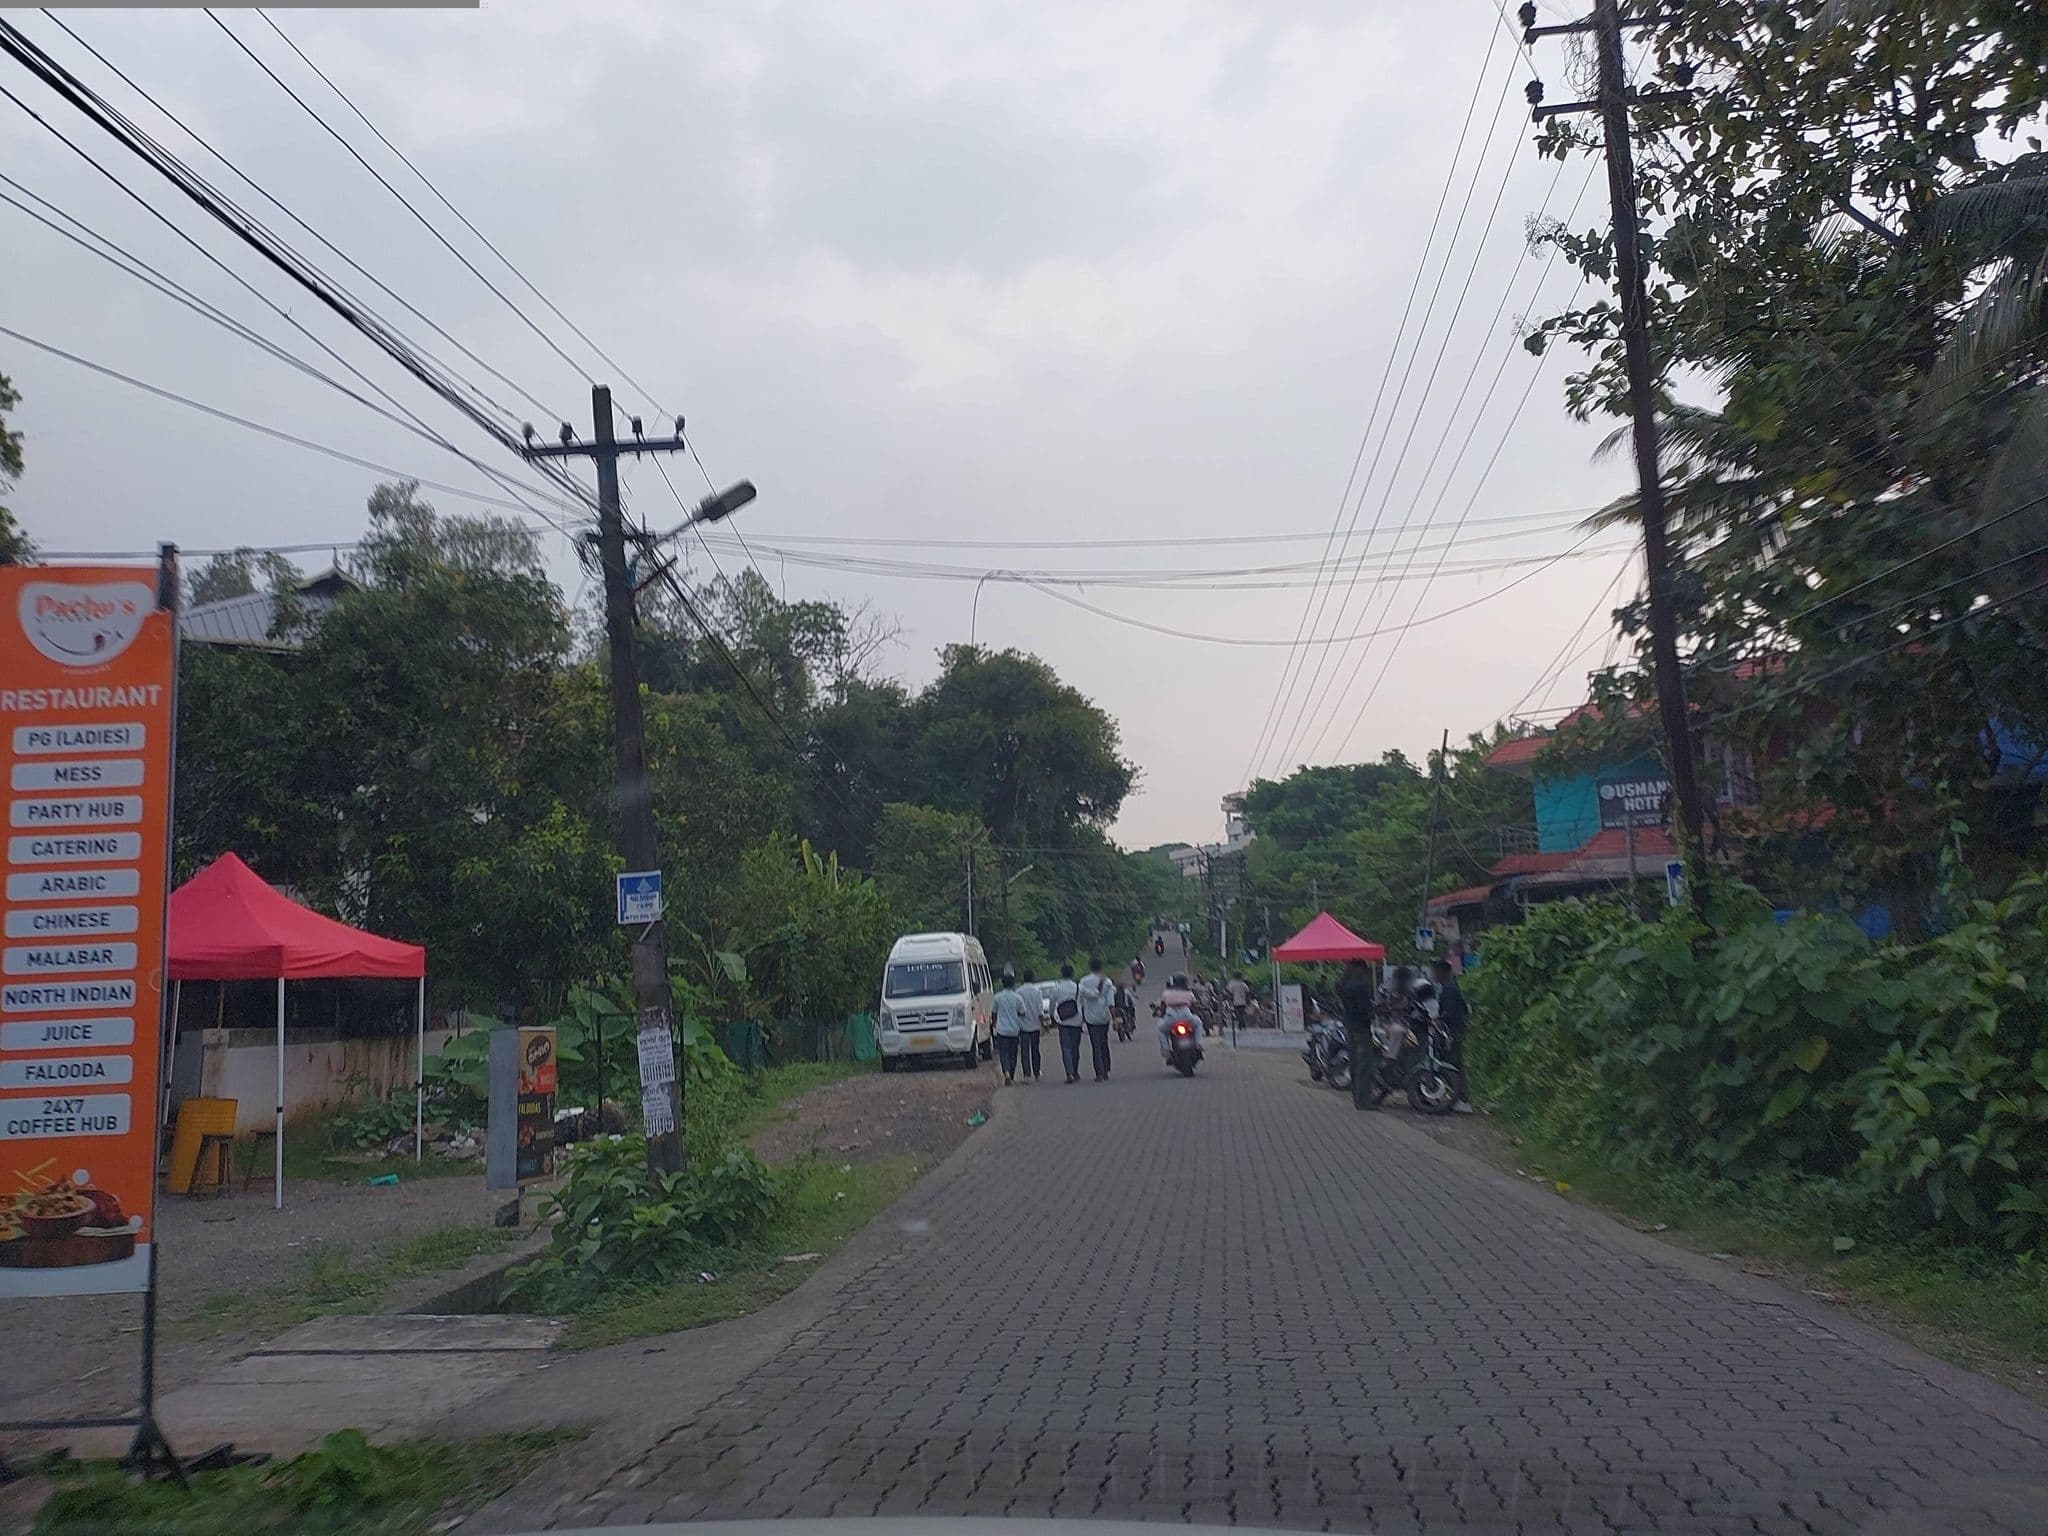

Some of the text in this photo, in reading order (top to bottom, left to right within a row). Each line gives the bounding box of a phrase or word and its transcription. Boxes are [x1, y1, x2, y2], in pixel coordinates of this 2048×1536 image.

[1, 684, 161, 711] RESTAURANT
[29, 728, 130, 746] PG (LADIES)
[54, 766, 102, 782] MESS
[28, 802, 124, 820] PARTY HUB
[32, 839, 117, 856] CATERING
[40, 876, 106, 892] ARABIC
[33, 912, 111, 929] CHINESE
[27, 949, 113, 966] MALABAR
[5, 985, 131, 1005] NORTH INDIAN
[42, 1025, 93, 1041] JUICE
[26, 1063, 105, 1080] FALOODA
[43, 1099, 85, 1114] 24X7
[8, 1116, 117, 1134] COFFEE HUB
